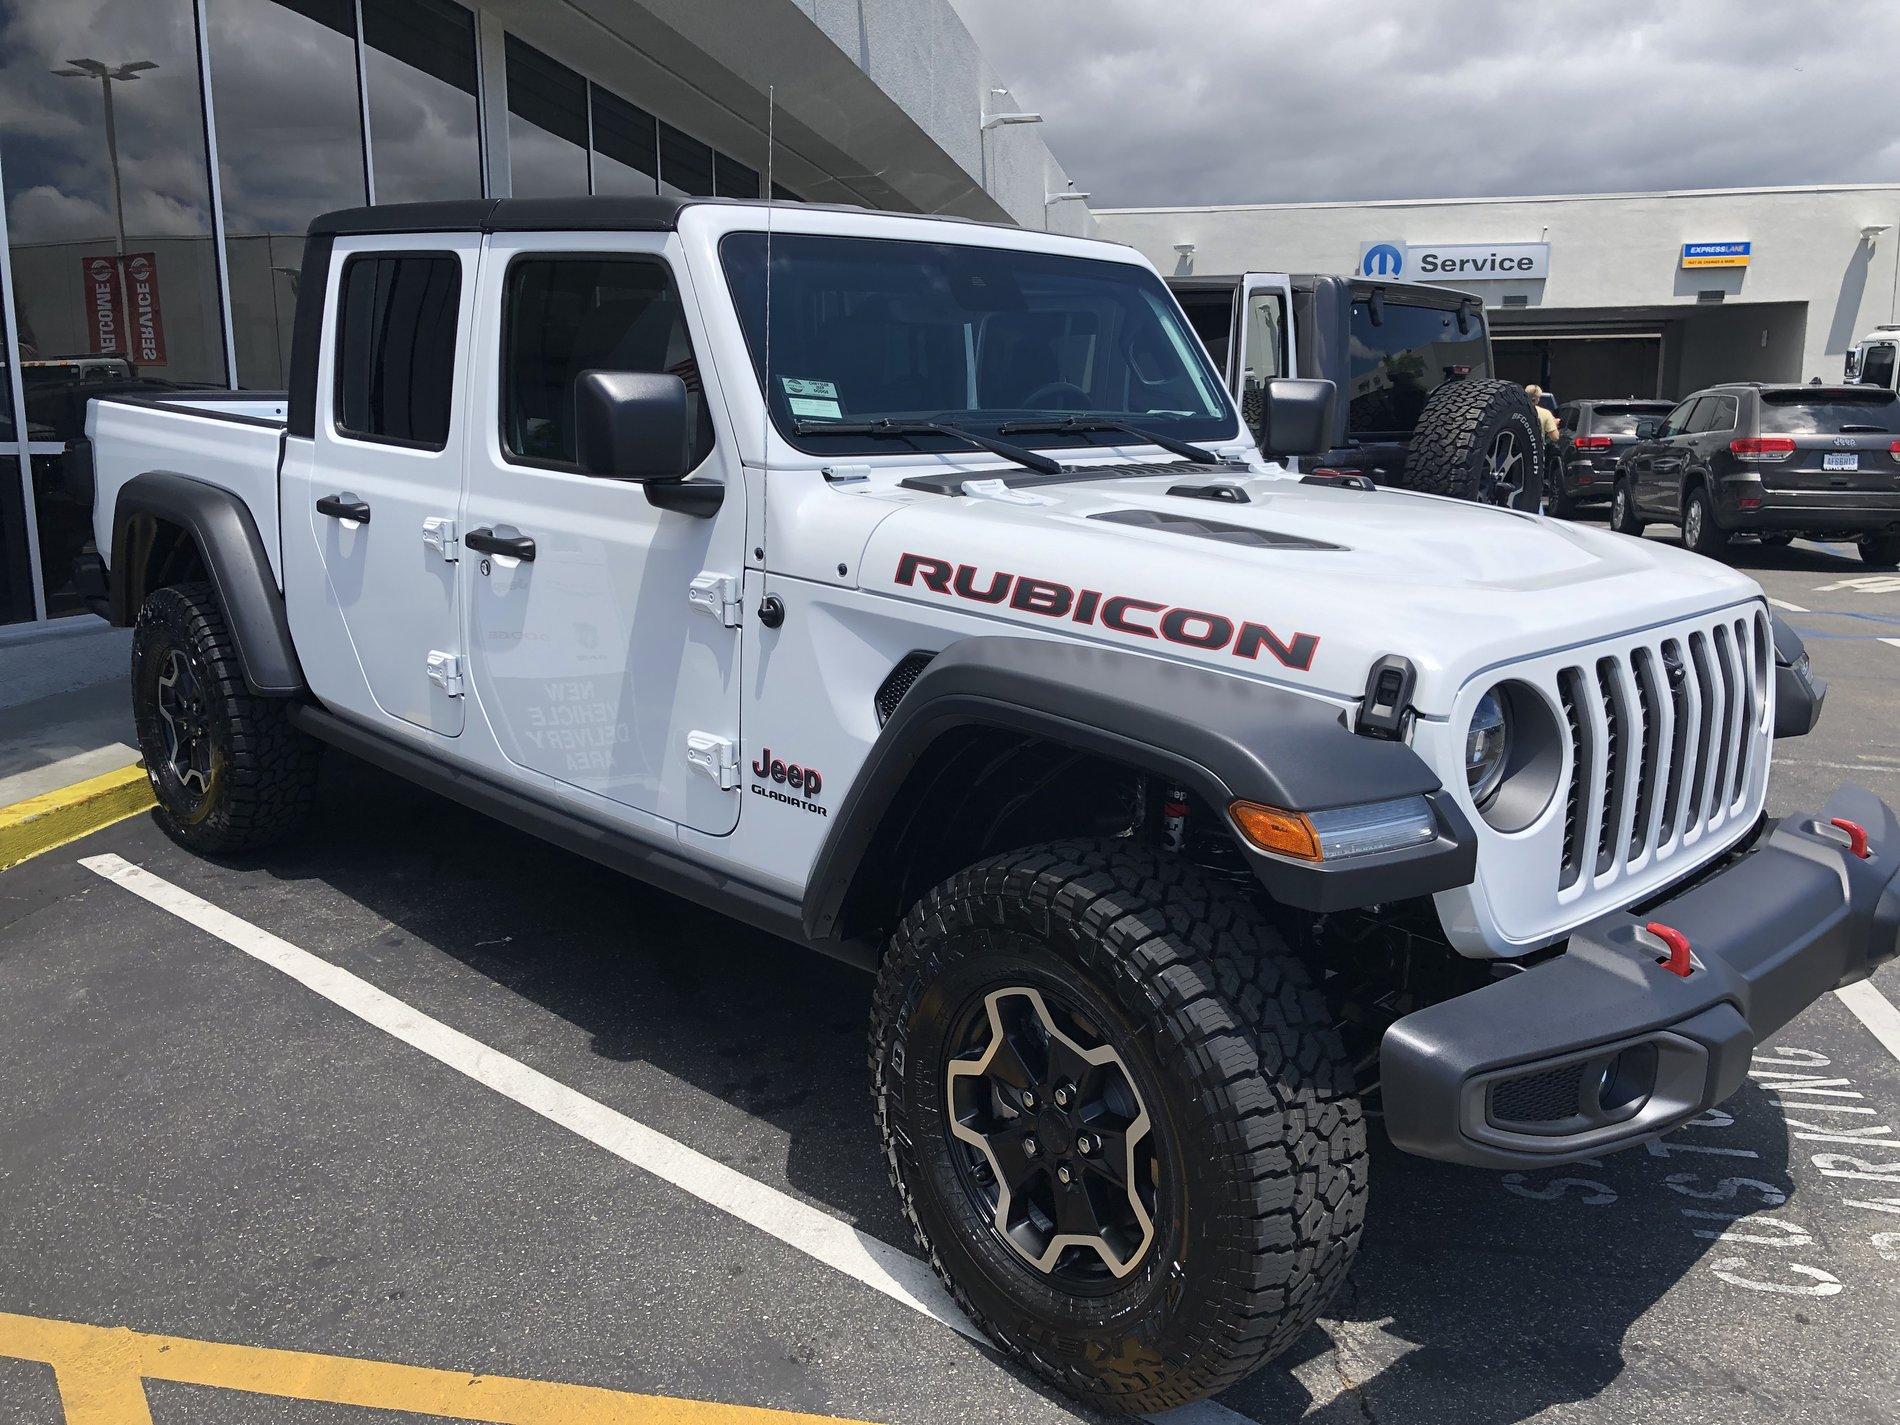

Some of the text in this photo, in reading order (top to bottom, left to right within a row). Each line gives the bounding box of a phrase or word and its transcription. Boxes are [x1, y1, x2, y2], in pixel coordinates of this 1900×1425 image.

[1420, 253, 1534, 273] Service
[1833, 437, 1856, 447] Jeep
[894, 552, 1320, 671] RUBICON
[752, 748, 822, 798] Jeep
[751, 784, 828, 818] GLADIATOR
